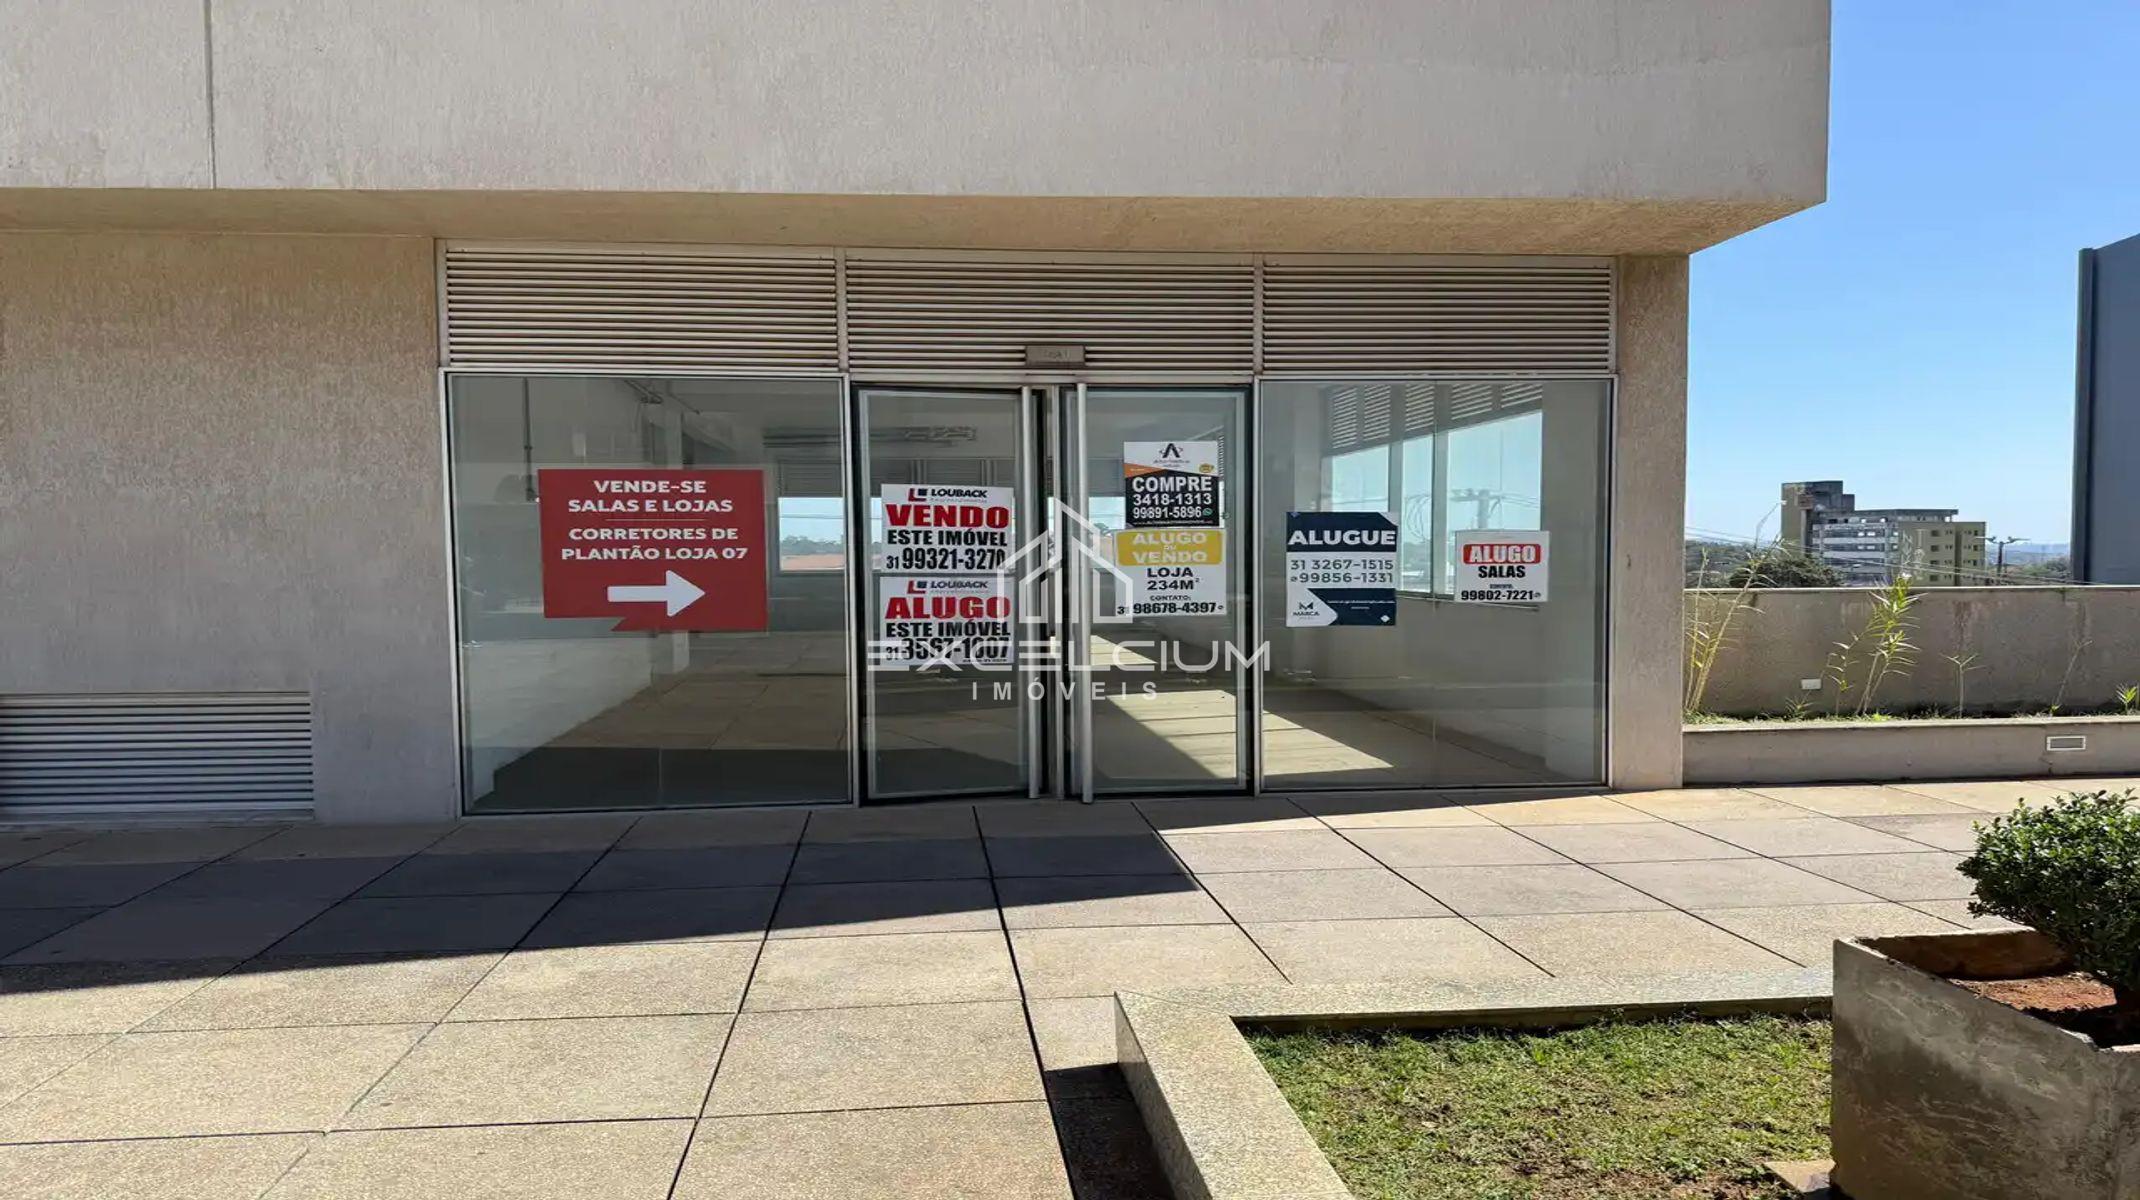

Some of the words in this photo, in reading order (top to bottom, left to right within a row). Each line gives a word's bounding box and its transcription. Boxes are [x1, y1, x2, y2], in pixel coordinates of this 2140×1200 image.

[594, 480, 707, 493] VENDE-SE
[1132, 476, 1212, 492] COMPRE
[931, 488, 988, 498] LOUBACK
[1133, 493, 1212, 506] 3418-1313
[568, 500, 640, 513] SALAS
[645, 500, 657, 513] E
[663, 500, 733, 513] LOJAS
[886, 504, 1009, 529] VENDO
[569, 528, 706, 541] CORRETORES
[712, 528, 738, 540] DE
[887, 530, 933, 545] ESTE
[938, 528, 1008, 546] IMÓVEL
[1132, 532, 1207, 545] ALUGO
[1288, 530, 1396, 545] ALUGUE
[562, 545, 659, 560] PLANTÃO
[665, 548, 718, 560] LOJA
[720, 548, 748, 560] 07
[1132, 551, 1207, 563] VENDO
[1470, 545, 1536, 563] ALUGO
[886, 555, 899, 569] 31
[1291, 560, 1305, 570] 31
[1312, 559, 1394, 570] 3267-1515
[1147, 567, 1193, 578] LOJA
[1300, 572, 1393, 583] 99856-1331
[1478, 565, 1526, 578] SALAS
[885, 596, 1010, 619] ALUGO
[1133, 602, 1216, 614] 98678-4397
[886, 622, 933, 637] ESTE
[938, 619, 1011, 637] IMÓVEL
